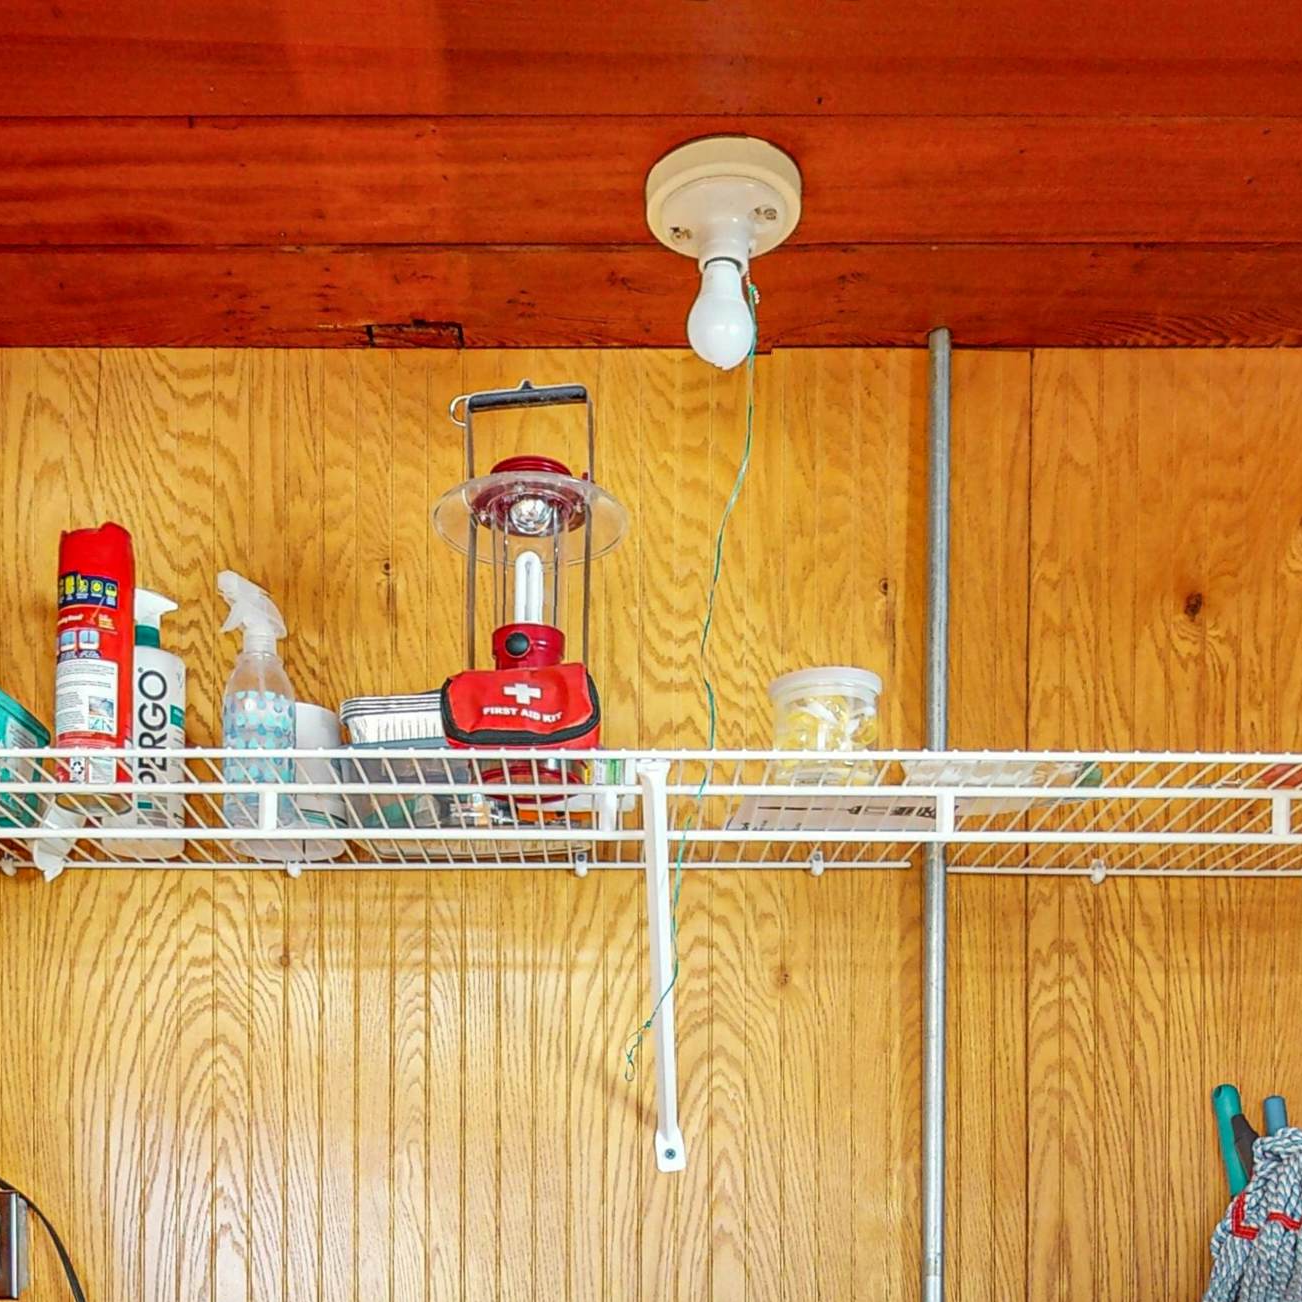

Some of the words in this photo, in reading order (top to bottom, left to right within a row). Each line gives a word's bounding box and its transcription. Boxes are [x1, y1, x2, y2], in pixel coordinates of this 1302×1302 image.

[482, 706, 518, 716] FIRST
[520, 707, 542, 721] AID
[542, 711, 563, 724] KIT
